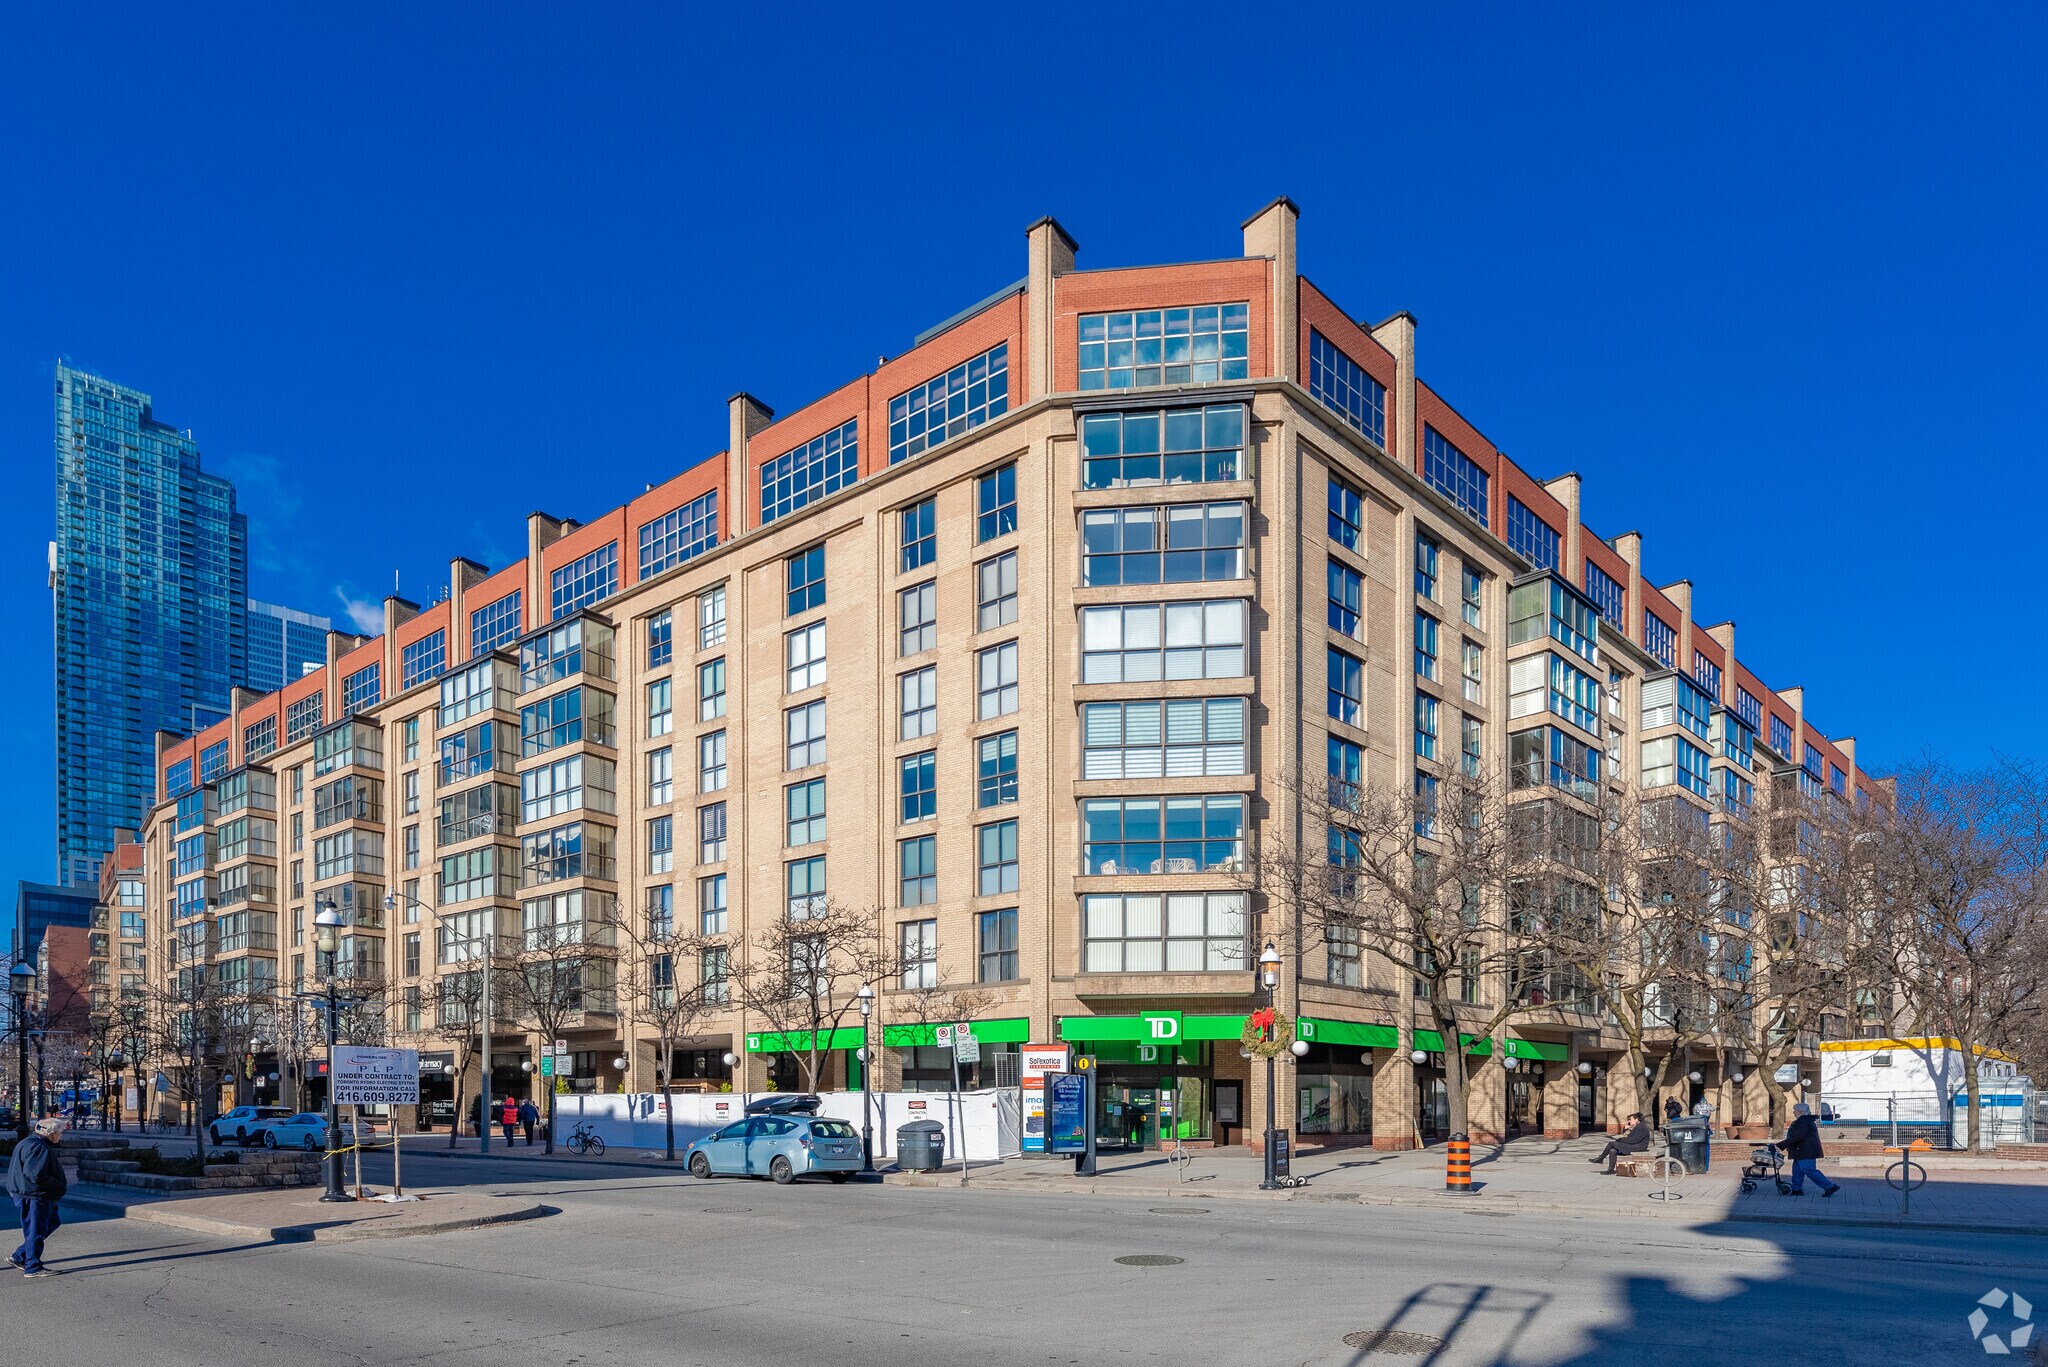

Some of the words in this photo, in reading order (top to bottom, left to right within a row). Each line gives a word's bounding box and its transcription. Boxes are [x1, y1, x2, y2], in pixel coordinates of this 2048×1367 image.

[1144, 1017, 1178, 1038] TD
[1301, 1022, 1314, 1037] TD
[747, 1037, 759, 1049] TD
[1136, 1045, 1157, 1062] TD
[337, 1092, 416, 1102] 416.609.8272
